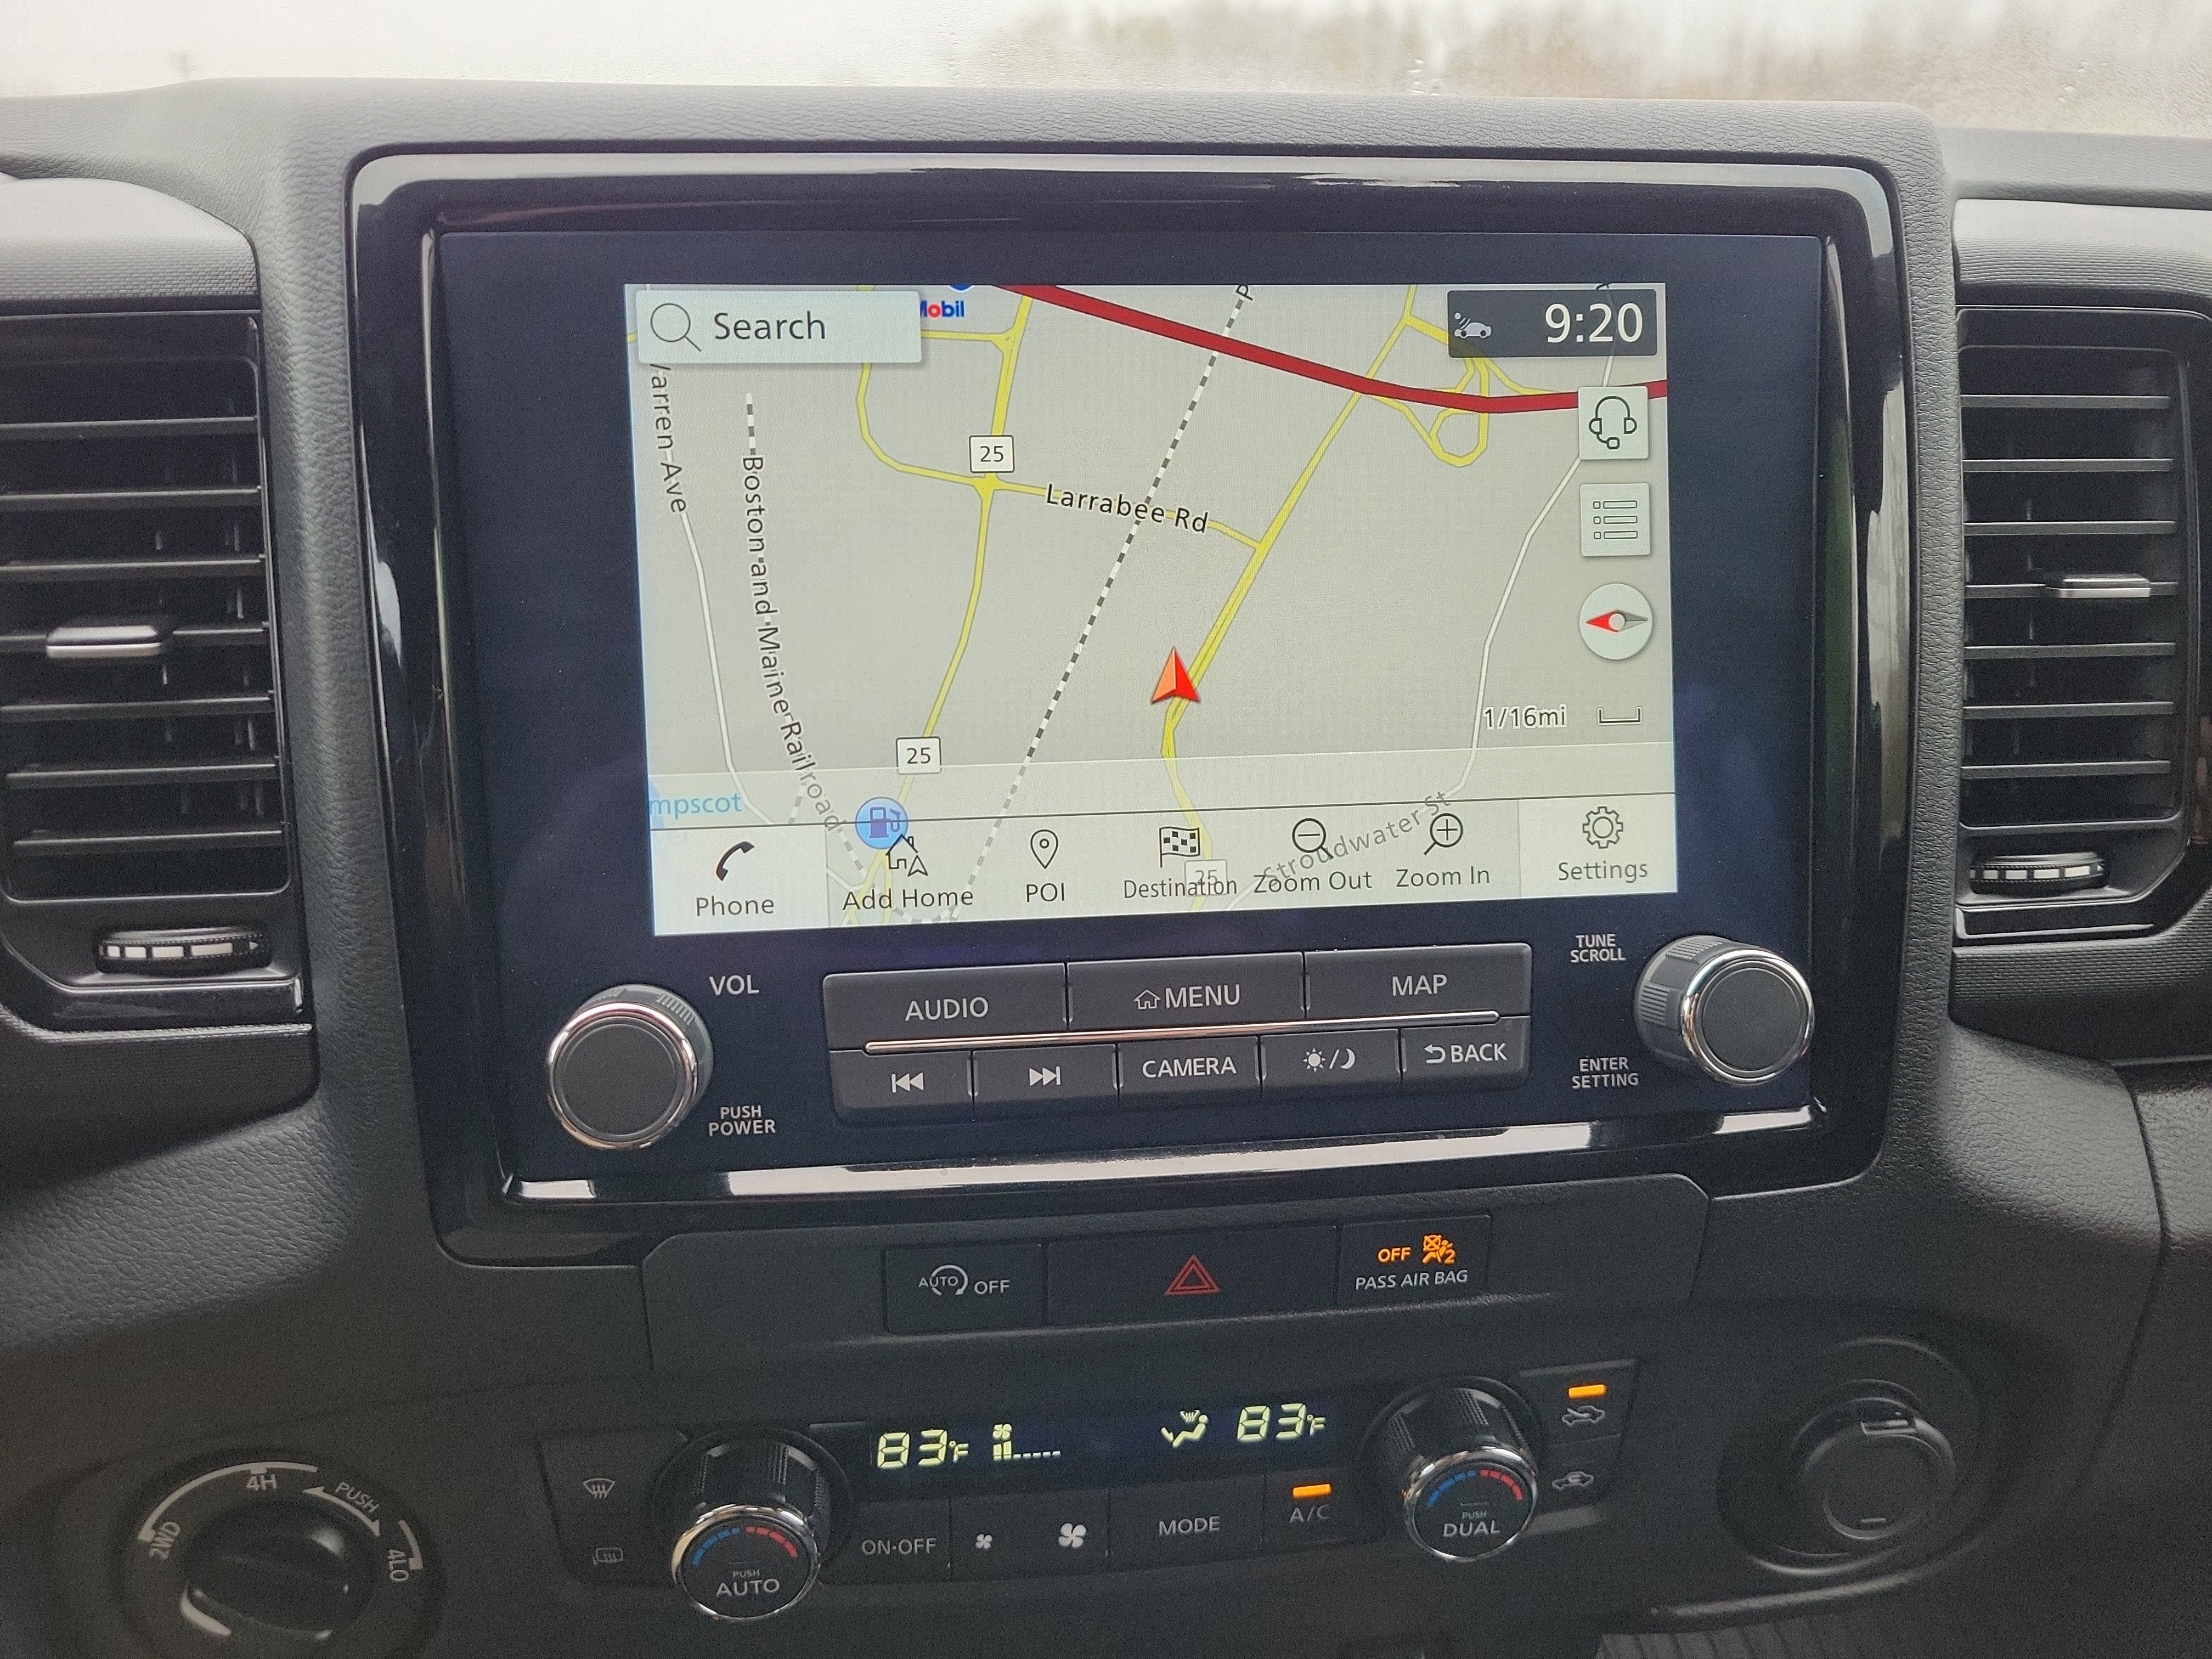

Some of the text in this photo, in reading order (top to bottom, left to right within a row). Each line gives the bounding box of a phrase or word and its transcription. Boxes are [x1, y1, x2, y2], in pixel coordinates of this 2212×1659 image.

[713, 311, 826, 340] Search
[1545, 302, 1644, 343] 9:20
[650, 363, 687, 513] arren Ave
[979, 445, 1005, 462] 25
[1046, 483, 1209, 533] Larrabee Rd
[742, 457, 847, 832] Boston and Maine Railroad
[1484, 704, 1567, 728] 1/16mi
[906, 747, 932, 765] 25
[1263, 791, 1452, 886] Stroudwater St
[1195, 870, 1217, 885] 25
[1254, 871, 1373, 893] Zoom Out
[1395, 865, 1491, 888] Zoom In
[1558, 860, 1648, 883] Settings
[1025, 882, 1066, 902] POI
[1124, 878, 1237, 899] Destination
[696, 896, 775, 917] Phone
[842, 888, 974, 911] Add Home
[1575, 933, 1616, 949] TUNE
[1570, 948, 1626, 964] SCROLL
[709, 974, 760, 996] VOL
[1392, 973, 1448, 996] MAP
[1165, 984, 1241, 1009] MENU
[905, 997, 989, 1022] AUDIO
[1451, 1042, 1508, 1063] BACK
[1142, 1056, 1237, 1079] CAMERA
[1579, 1057, 1629, 1073] ENTER
[1572, 1073, 1639, 1090] SETTING
[720, 1105, 762, 1120] PUSH
[708, 1120, 776, 1137] POWER
[1378, 1246, 1412, 1263] OFF
[918, 1275, 1011, 1295] AUTO OFF
[1355, 1269, 1468, 1290] PASS AIR BAG
[246, 1474, 278, 1492] 4H
[335, 1482, 380, 1513] PUSH
[1289, 1503, 1330, 1525] A/C
[1462, 1509, 1488, 1520] PUSH
[1158, 1515, 1221, 1537] MODE
[1442, 1520, 1500, 1537] DUAL
[149, 1520, 181, 1560] 2WD
[387, 1548, 409, 1583] 4LO
[732, 1568, 761, 1578] PUSH
[715, 1578, 781, 1597] AUTO
